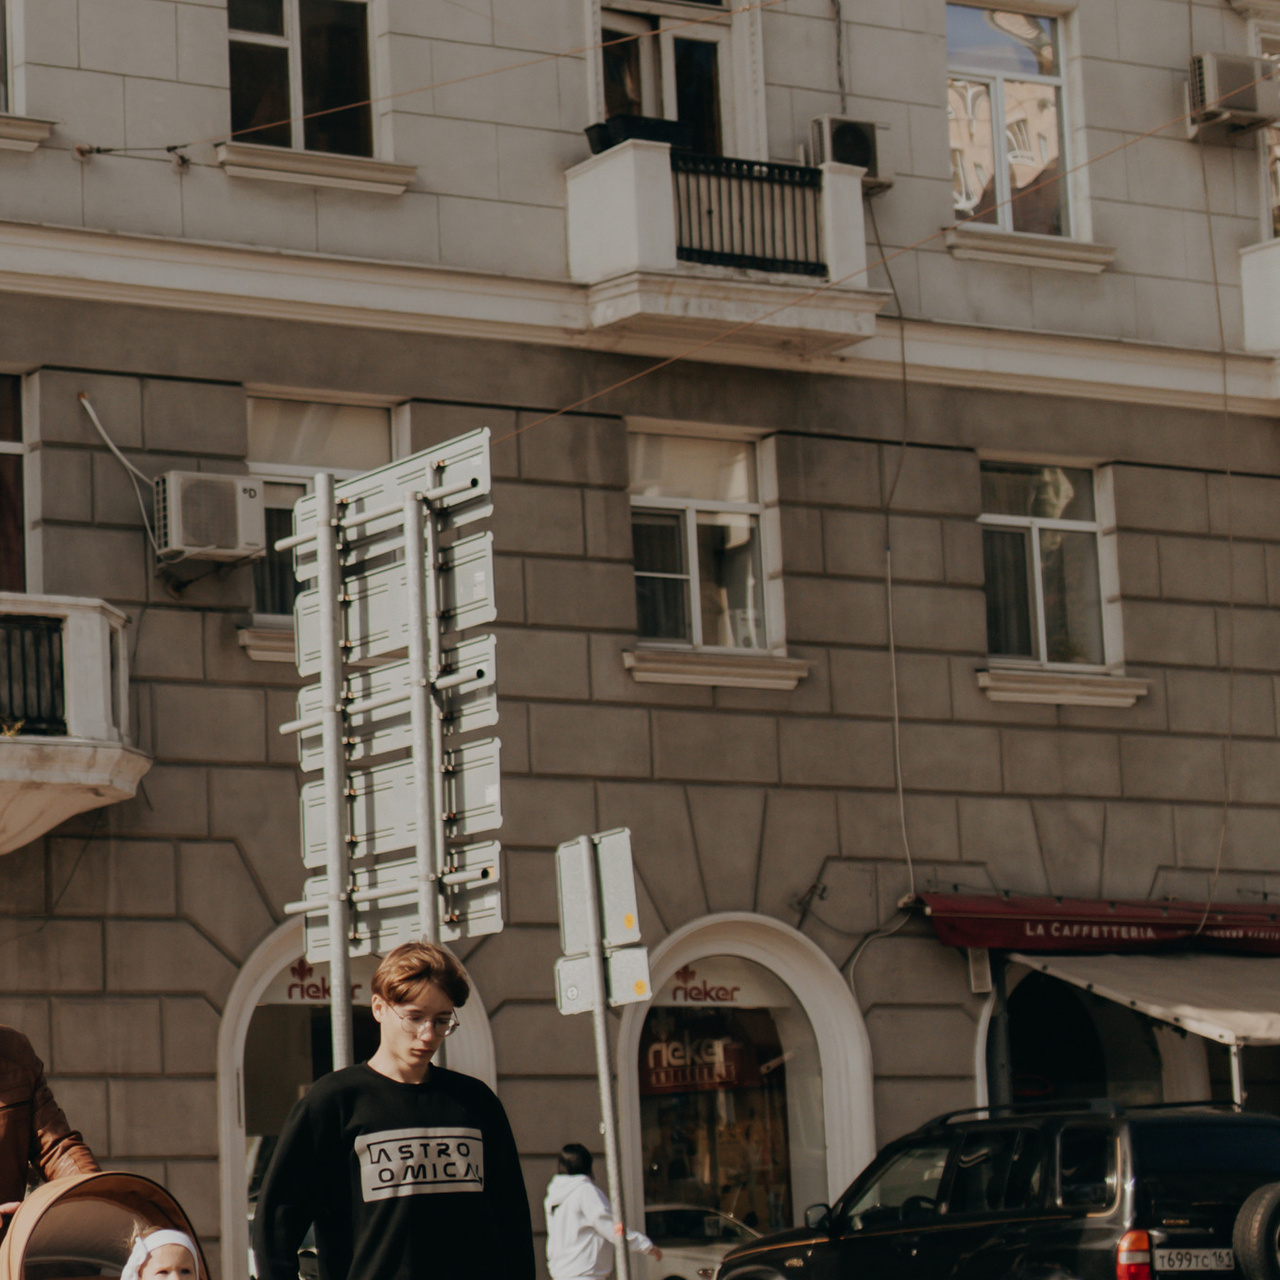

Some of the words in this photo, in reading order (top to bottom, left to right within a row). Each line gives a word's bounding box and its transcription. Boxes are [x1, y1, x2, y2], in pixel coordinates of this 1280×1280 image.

[1026, 922, 1044, 936] LA
[287, 976, 362, 1000] riekr
[672, 979, 741, 1002] rieker
